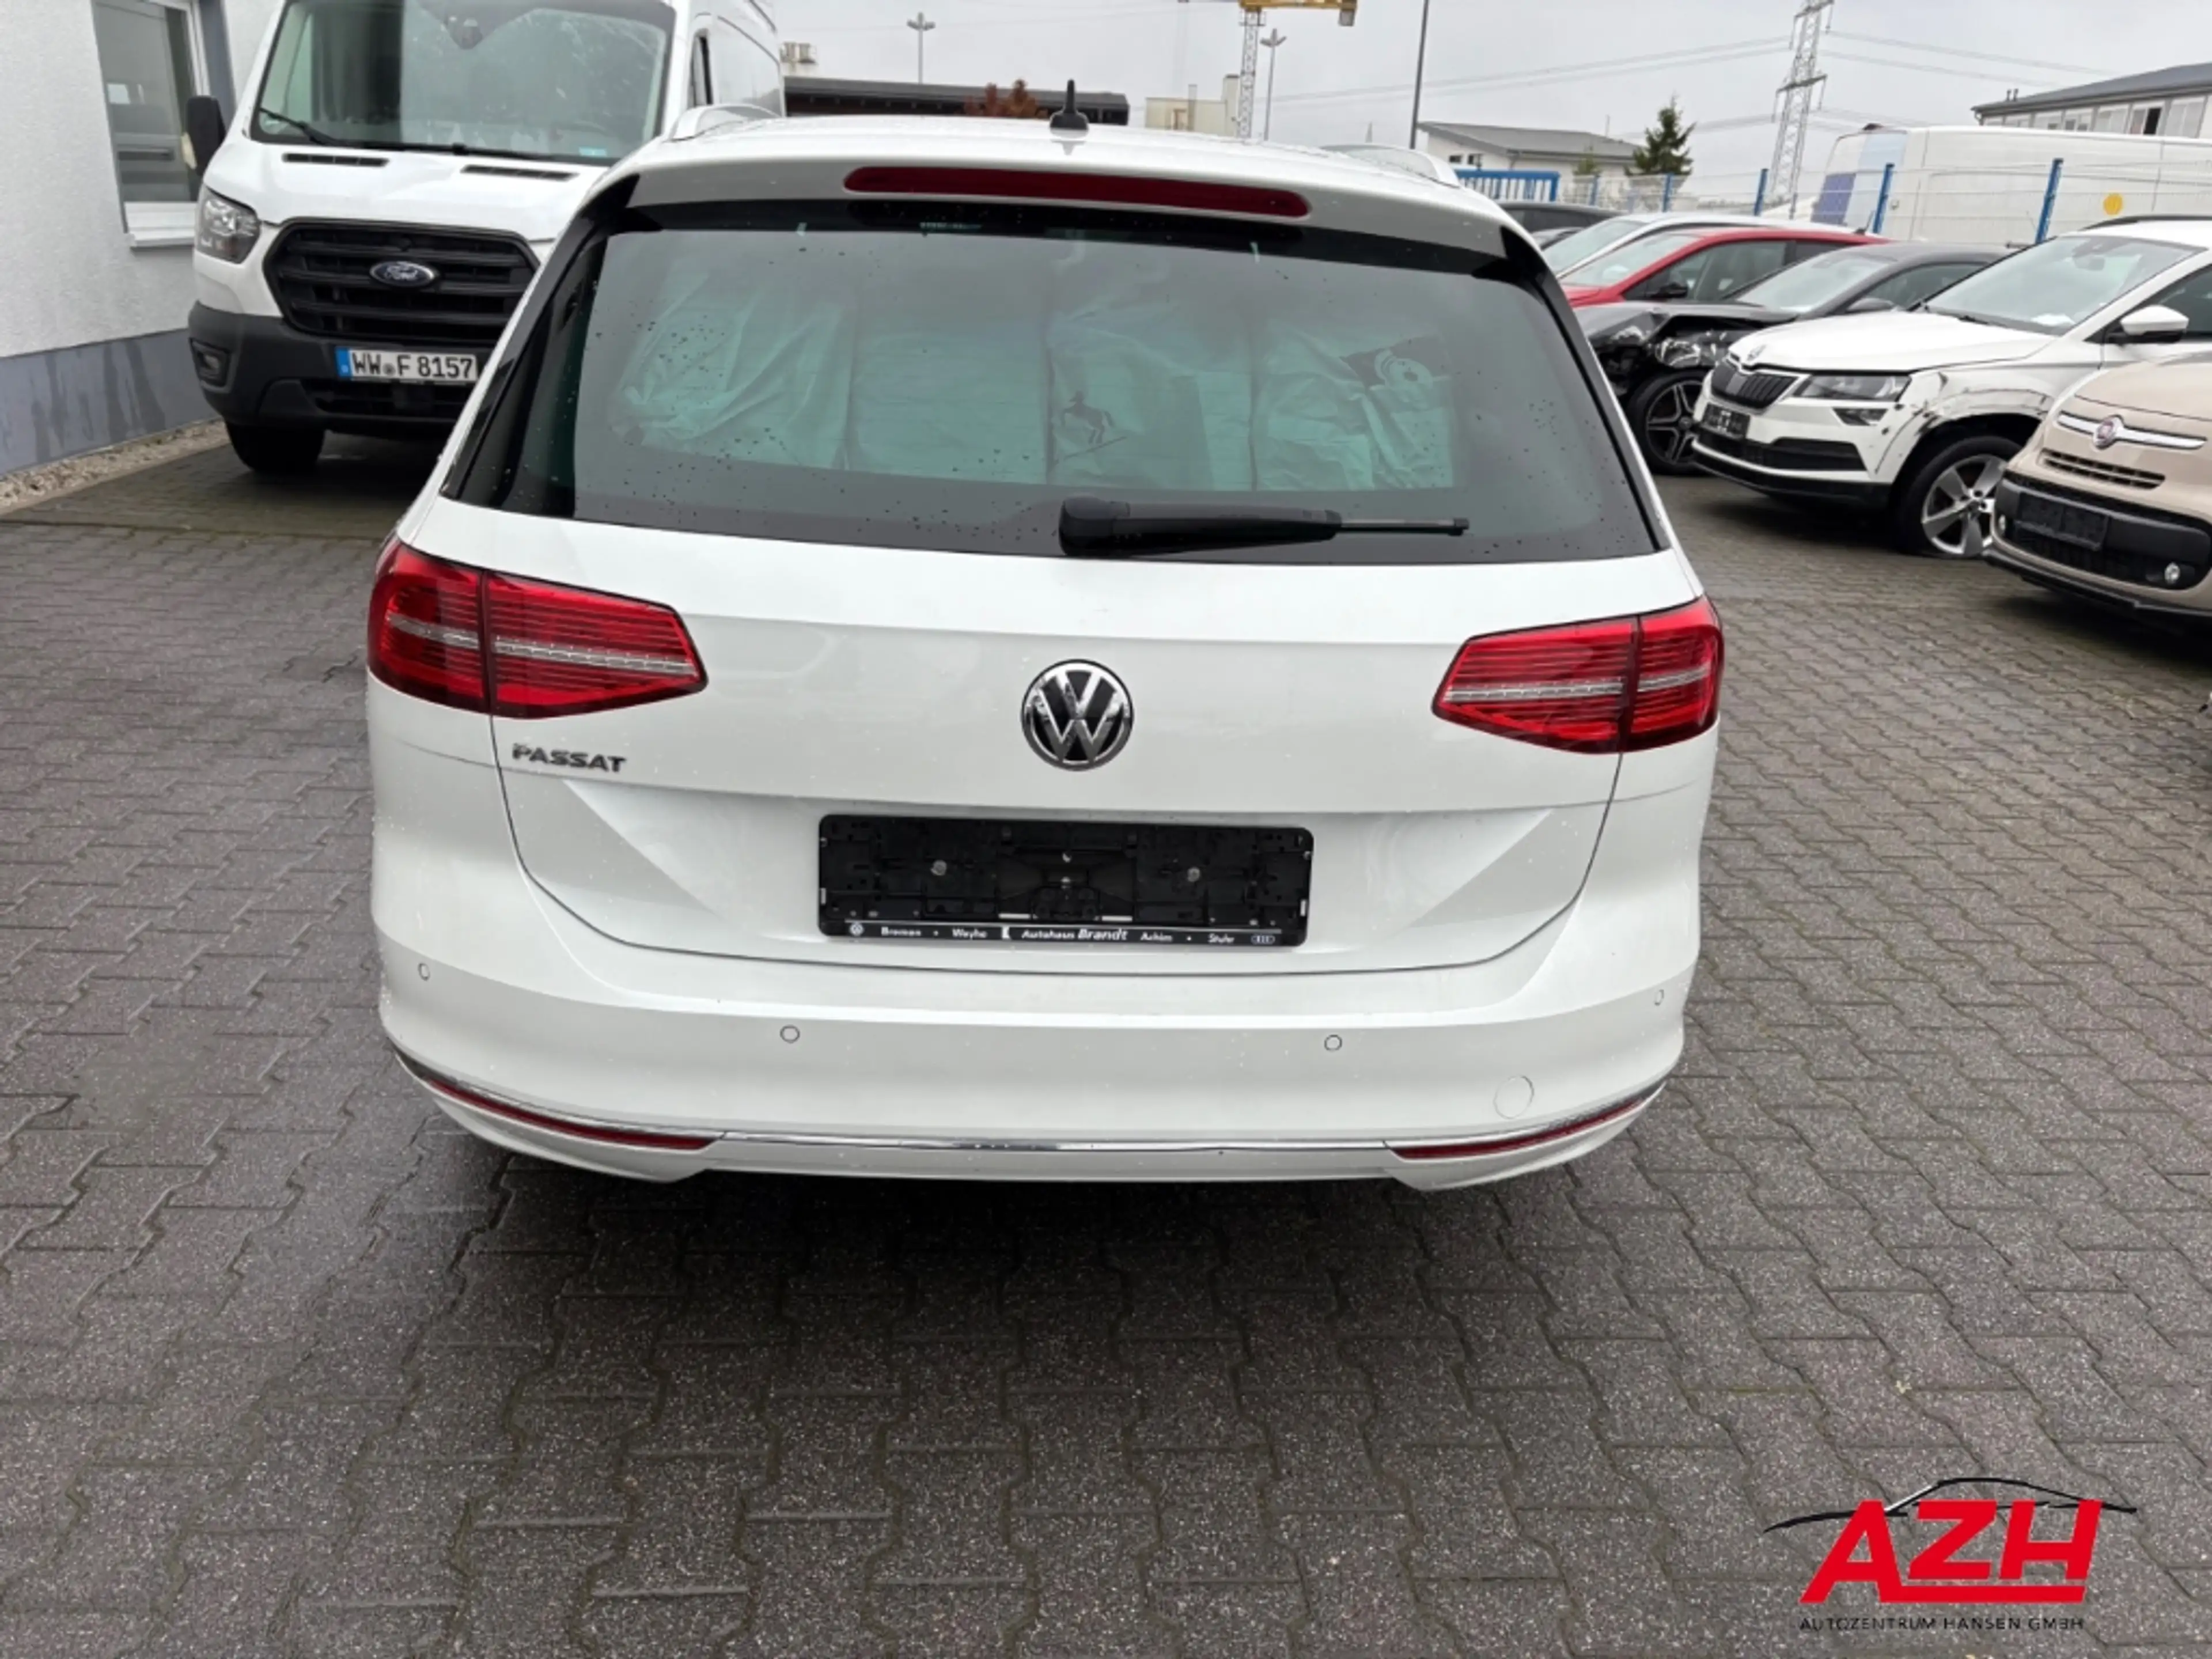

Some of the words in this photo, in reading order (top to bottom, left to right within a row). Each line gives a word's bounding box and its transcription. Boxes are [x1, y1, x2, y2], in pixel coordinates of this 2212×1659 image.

[351, 353, 381, 374] WW
[397, 354, 411, 376] F
[416, 355, 473, 379] 8157
[512, 743, 627, 773] PASSAT
[881, 926, 922, 937] Bremen
[1021, 929, 1075, 940] Autohaus
[1077, 926, 1128, 941] Brandt
